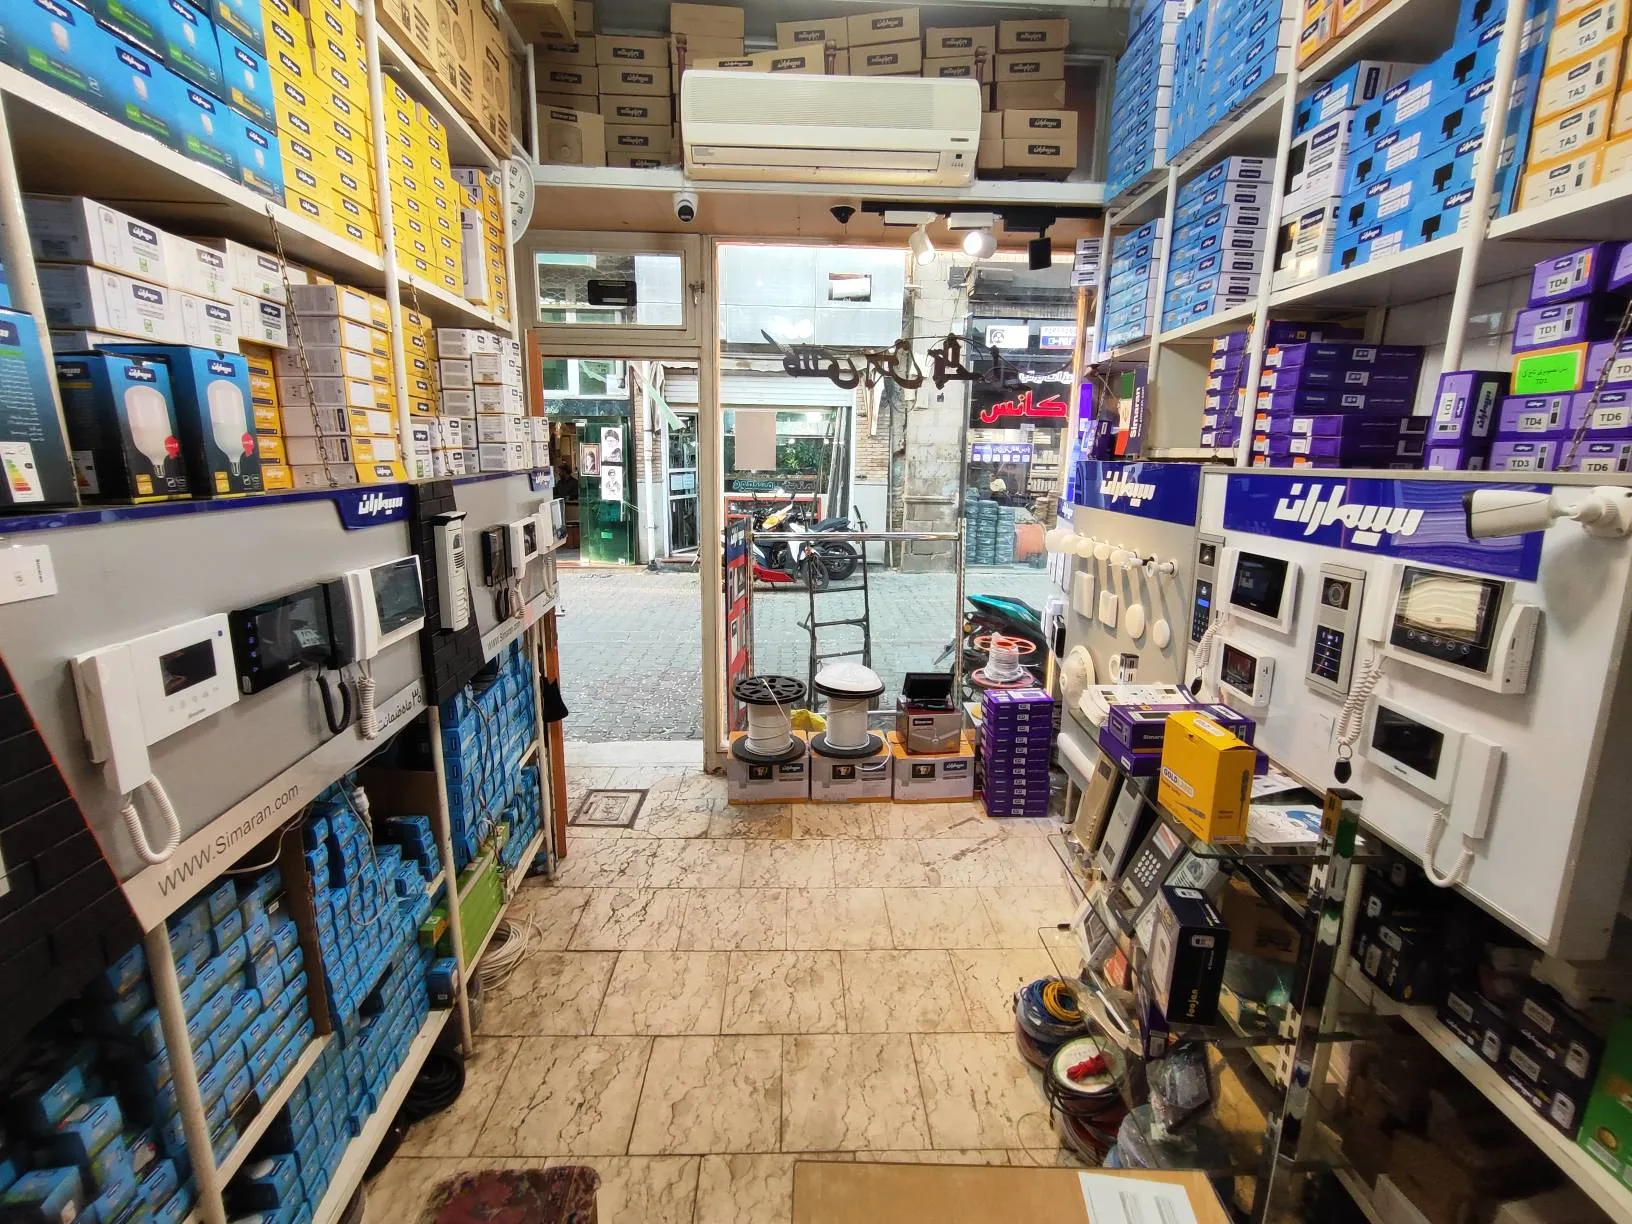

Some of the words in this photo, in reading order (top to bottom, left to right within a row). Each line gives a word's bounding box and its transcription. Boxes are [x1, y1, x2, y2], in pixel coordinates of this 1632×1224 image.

[1578, 31, 1597, 46] TA3
[1567, 84, 1586, 97] TA3
[1559, 134, 1577, 148] TA3
[1549, 184, 1566, 196] TA3
[1549, 276, 1568, 290] TD4
[1538, 325, 1557, 336] TD1
[980, 389, 1069, 424] کانس
[1130, 386, 1140, 438] Simaran
[1478, 390, 1492, 429] سیماران
[1524, 417, 1542, 426] TD4
[1600, 412, 1622, 422] TD6
[1512, 459, 1530, 468] TD3
[1587, 464, 1609, 472] TD6
[1100, 471, 1156, 508] سیماران
[358, 493, 404, 516] سیماران
[1274, 483, 1425, 547] سیماران
